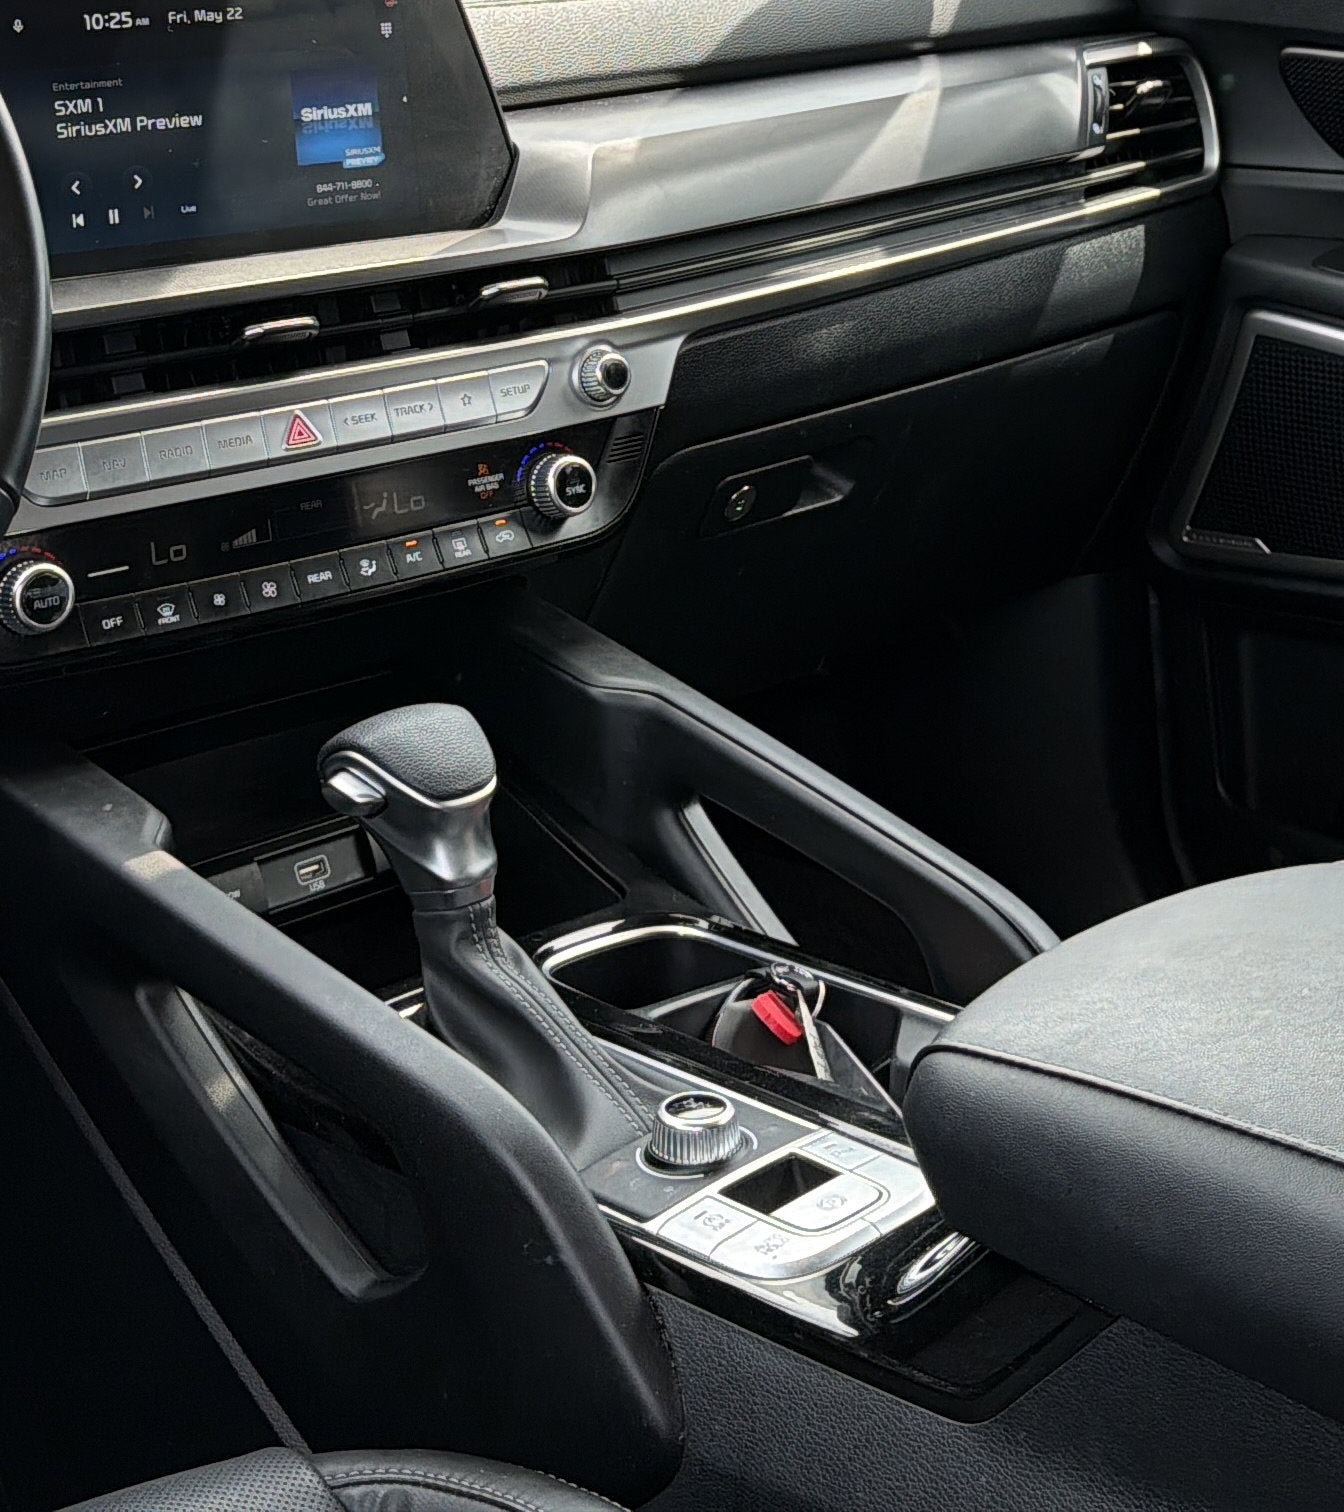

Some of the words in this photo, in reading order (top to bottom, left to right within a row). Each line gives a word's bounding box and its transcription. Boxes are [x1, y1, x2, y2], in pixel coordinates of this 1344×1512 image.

[83, 11, 133, 31] 10:25
[135, 16, 150, 26] AM
[167, 11, 191, 25] Fri,
[194, 9, 223, 24] May
[226, 7, 243, 20] 22
[52, 78, 123, 92] Entertainment
[54, 99, 93, 116] SXM
[97, 97, 104, 113] 1
[300, 102, 373, 122] SiriusXM
[56, 117, 132, 139] SiriusXM
[136, 113, 203, 131] Preview
[307, 196, 333, 207] Great
[335, 193, 358, 204] Offer
[499, 383, 531, 398] SETUP
[217, 434, 254, 449] MEDIA
[159, 445, 194, 460] RADIO
[102, 458, 126, 471] NAV
[39, 467, 68, 481] MAP
[565, 484, 586, 496] SYNC
[393, 492, 426, 514] Lo
[150, 541, 187, 566] Lo
[406, 552, 423, 564] A/C
[306, 570, 333, 585] REAR
[32, 595, 61, 610] AUTO
[101, 615, 124, 631] OFF
[157, 613, 181, 626] FRONT
[309, 879, 326, 893] USB
